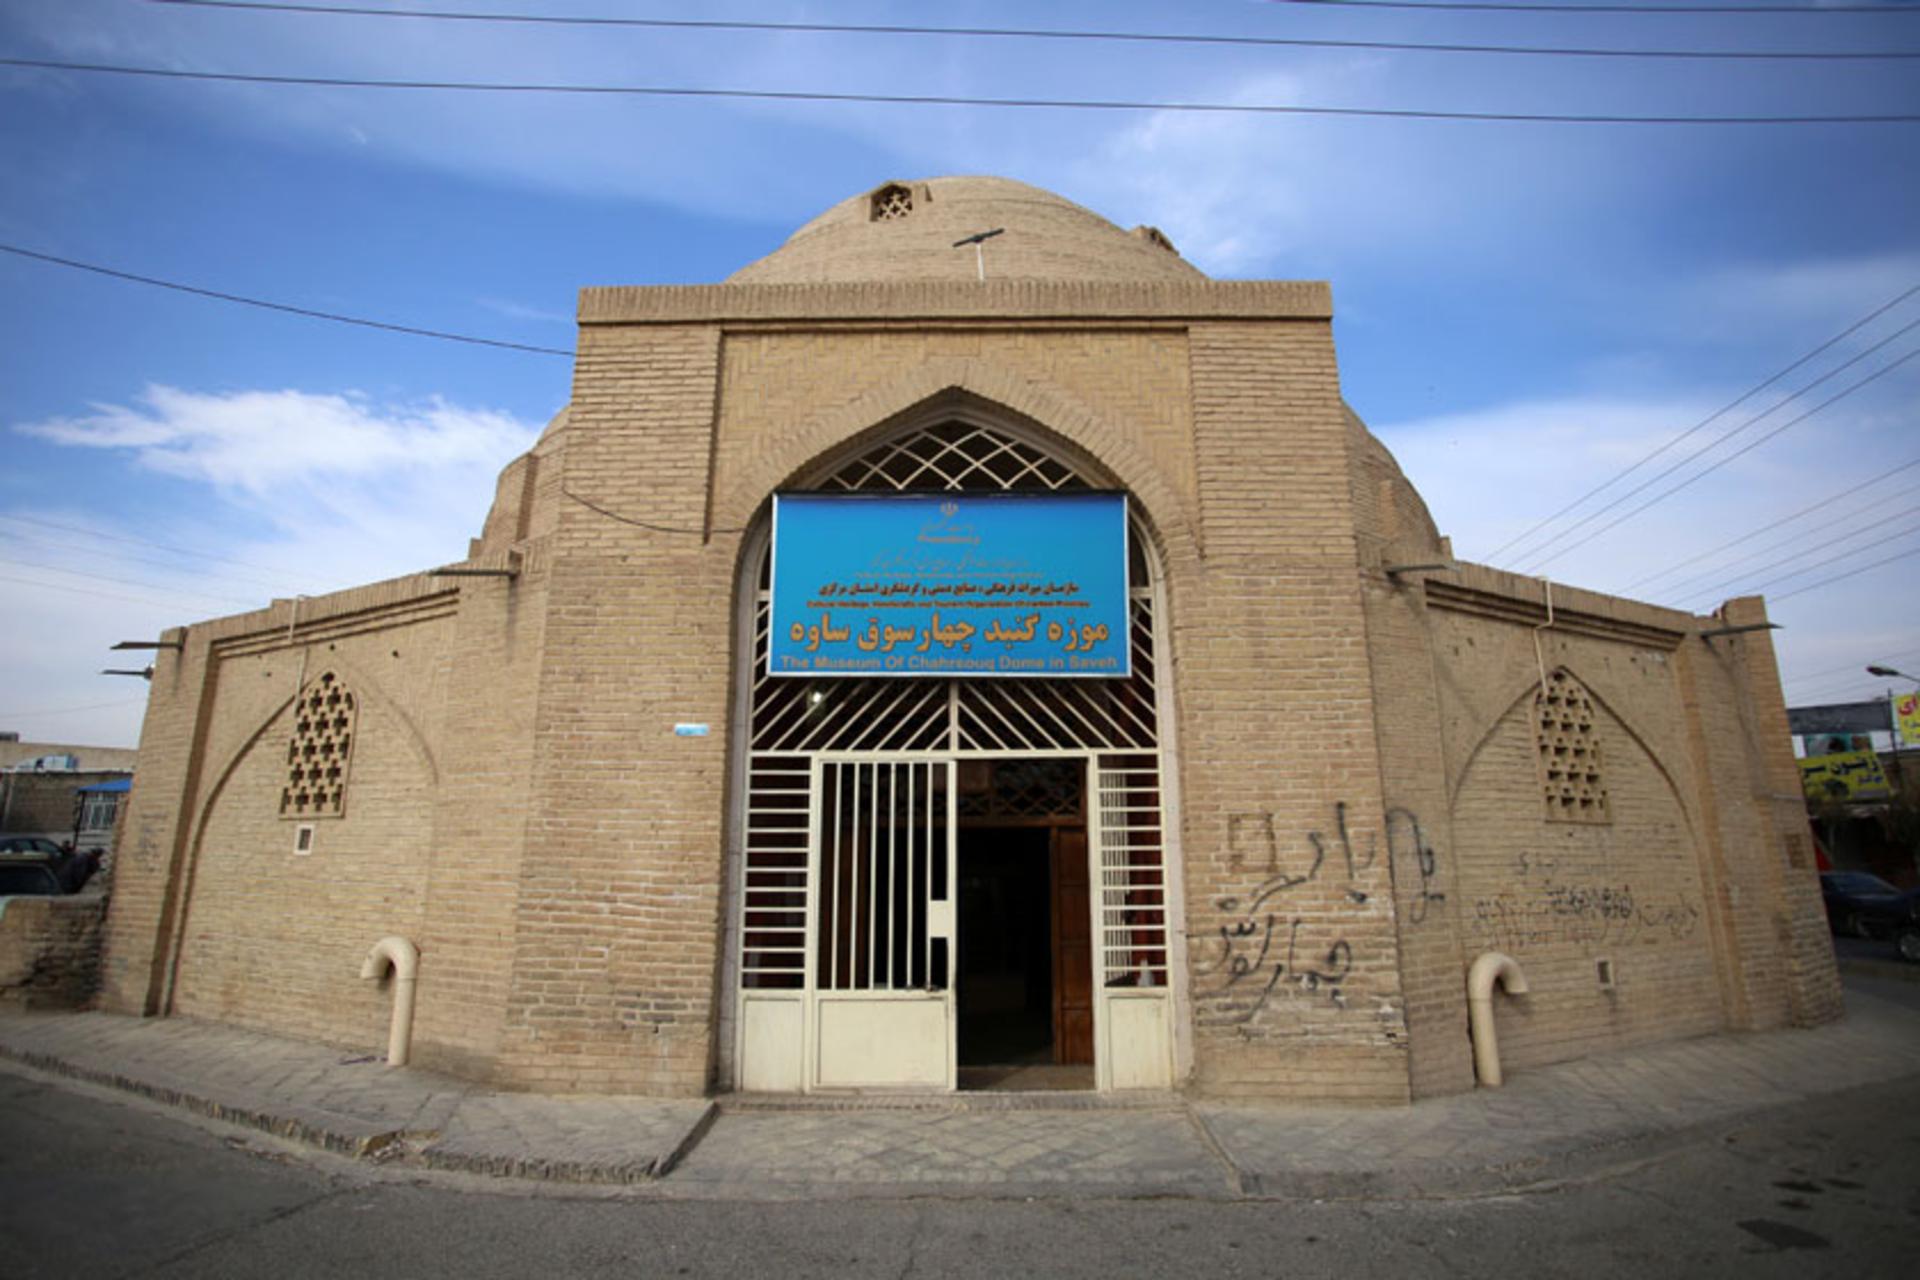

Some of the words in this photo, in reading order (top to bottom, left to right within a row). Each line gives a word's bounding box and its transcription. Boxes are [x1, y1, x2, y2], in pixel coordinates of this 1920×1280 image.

[790, 612, 850, 652] ساوه
[984, 613, 1041, 651] گنبد
[1048, 617, 1108, 651] موزه
[782, 655, 809, 669] The
[815, 655, 881, 669] Museum
